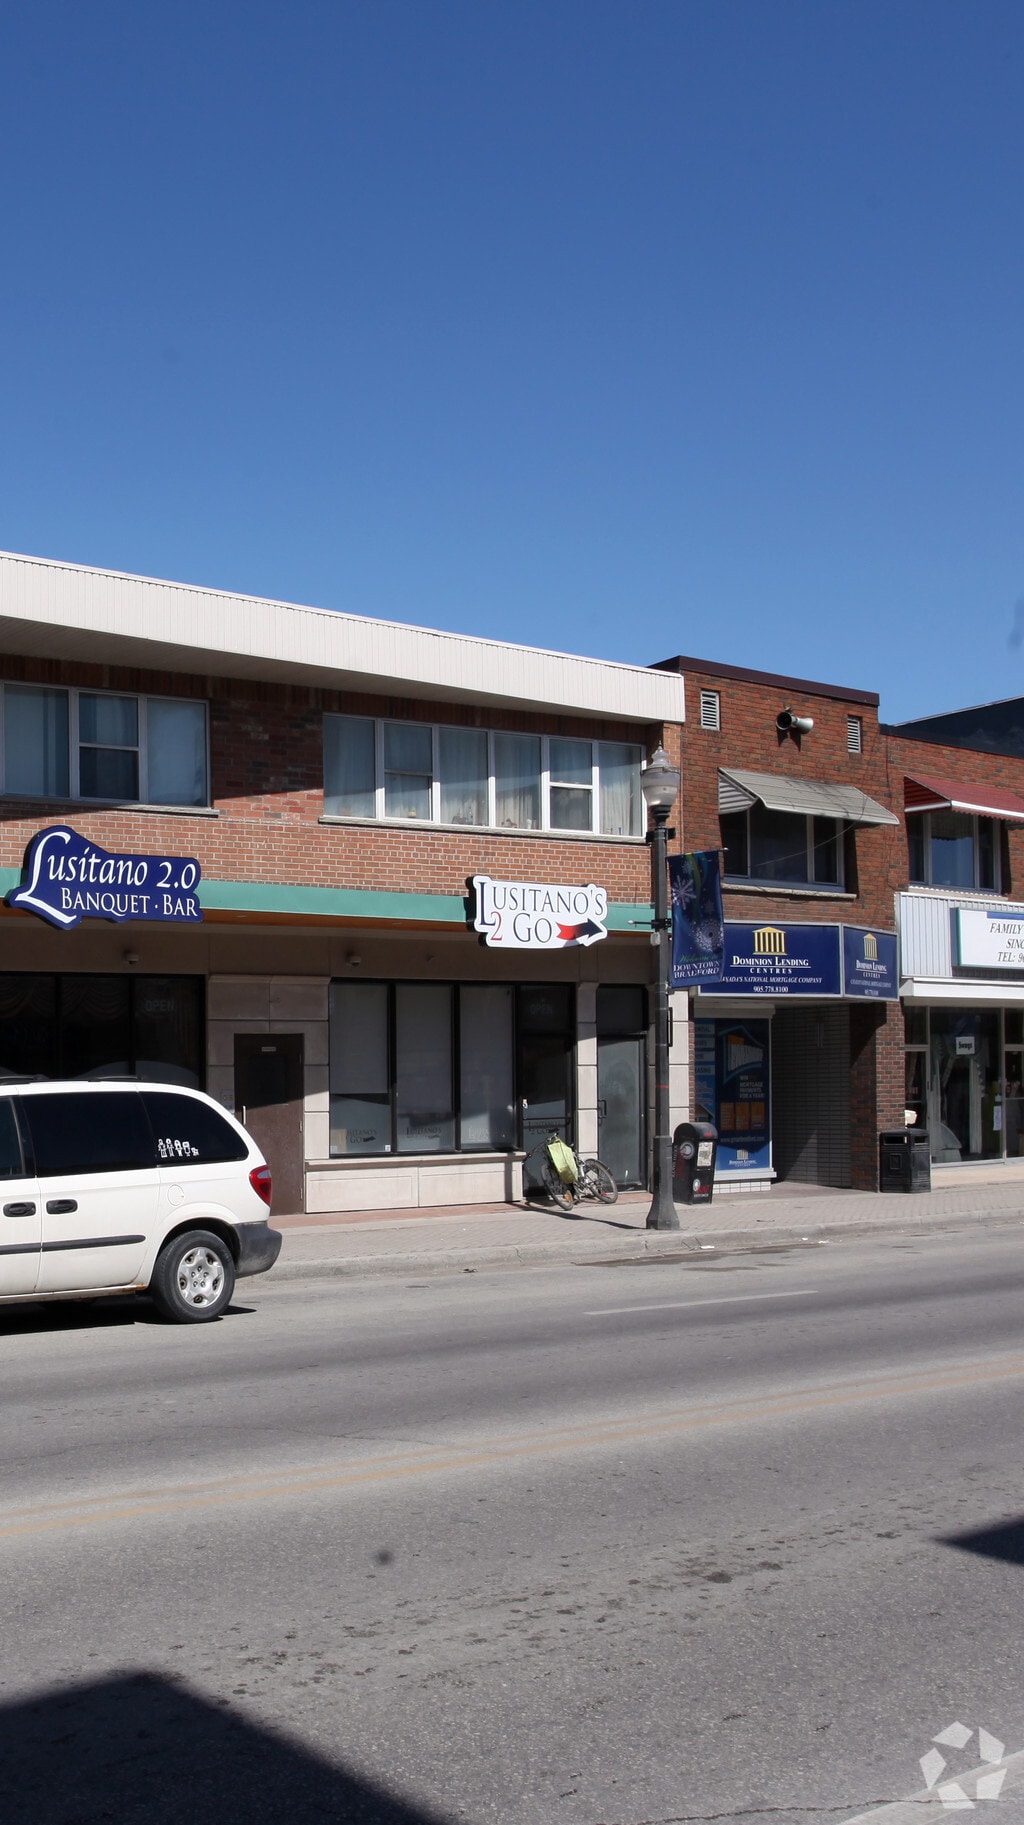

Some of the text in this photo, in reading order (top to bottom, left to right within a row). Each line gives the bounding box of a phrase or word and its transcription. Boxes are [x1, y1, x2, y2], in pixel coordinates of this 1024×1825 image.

[14, 831, 196, 924] Lusitano 2.0
[61, 887, 198, 917] BANQUET BAR
[479, 882, 604, 926] LUSITANO'S
[490, 911, 552, 943] 2 GO
[989, 922, 1024, 935] FAMILY
[732, 955, 809, 966] DOMINION LENDING
[997, 951, 1016, 963] TEL:
[673, 960, 721, 972] DOWNTOWN
[674, 967, 720, 979] BRADFORD
